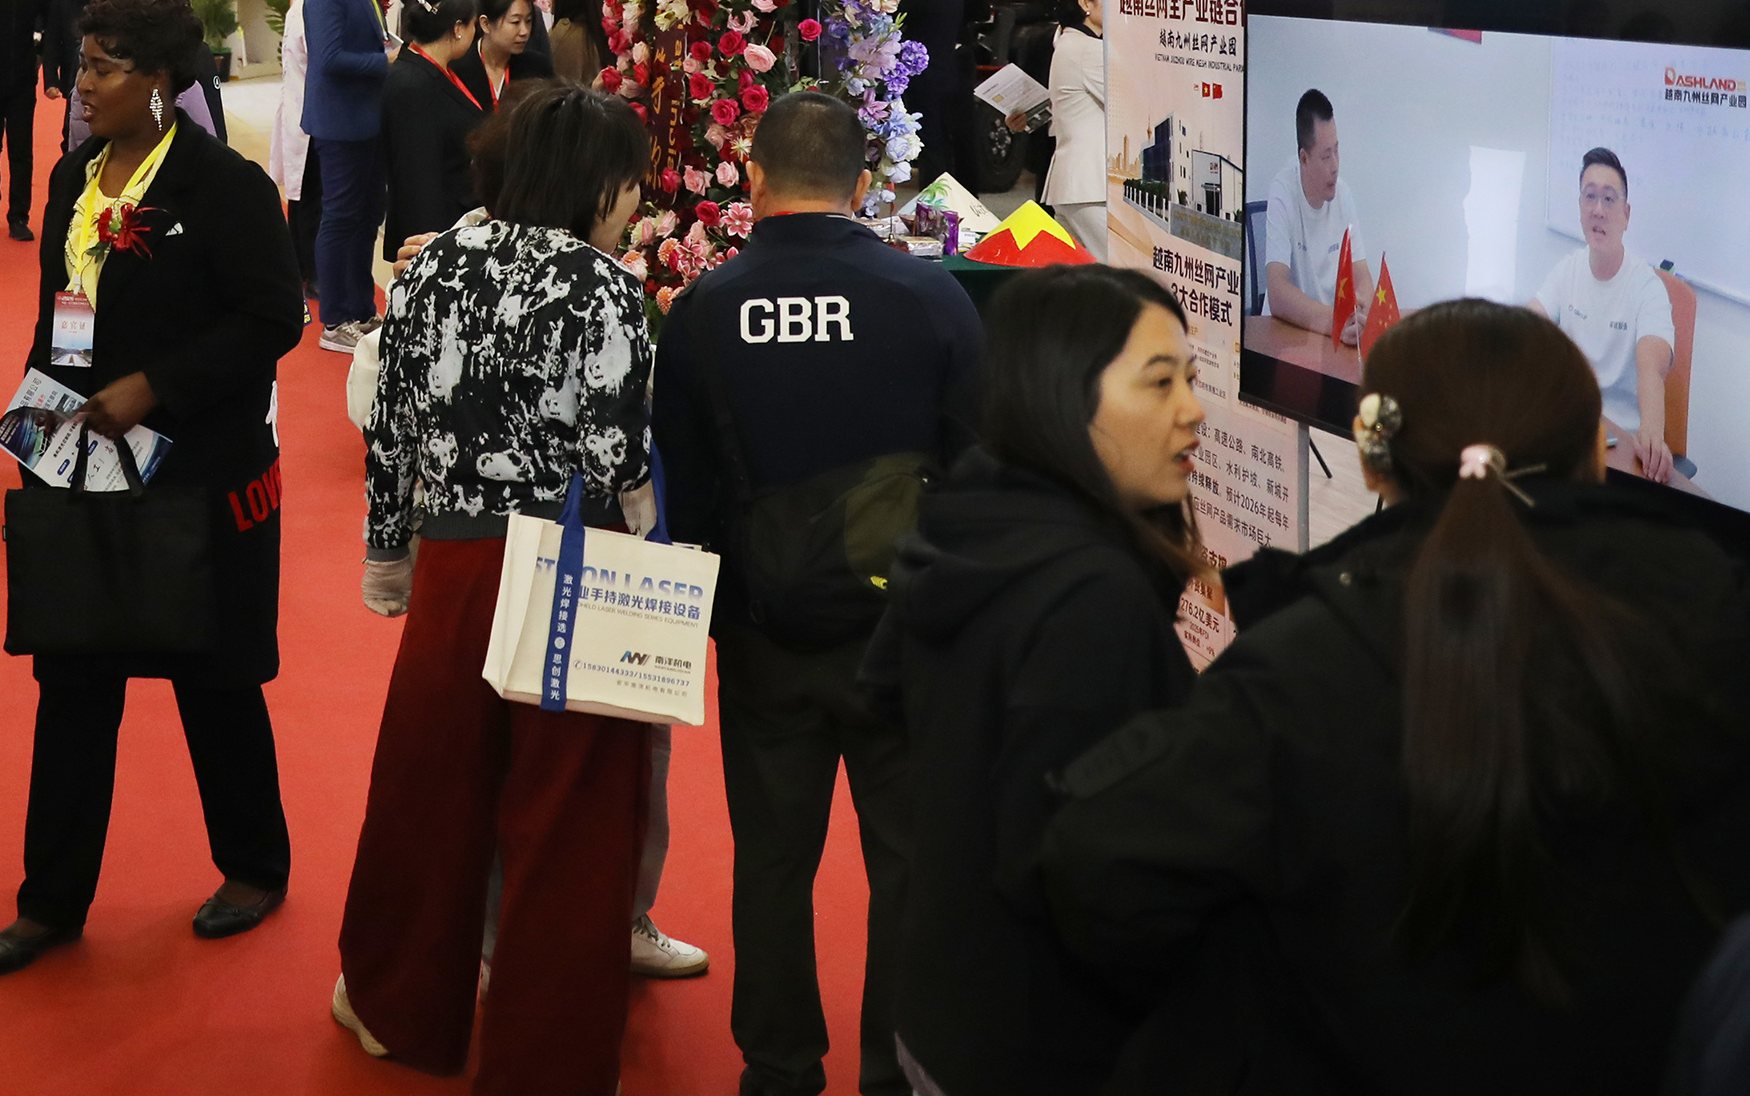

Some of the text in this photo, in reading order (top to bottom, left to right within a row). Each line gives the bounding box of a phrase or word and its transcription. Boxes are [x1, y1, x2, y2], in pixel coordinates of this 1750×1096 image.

[1152, 245, 1241, 296] 越南九州丝网产业
[739, 295, 854, 344] GBR
